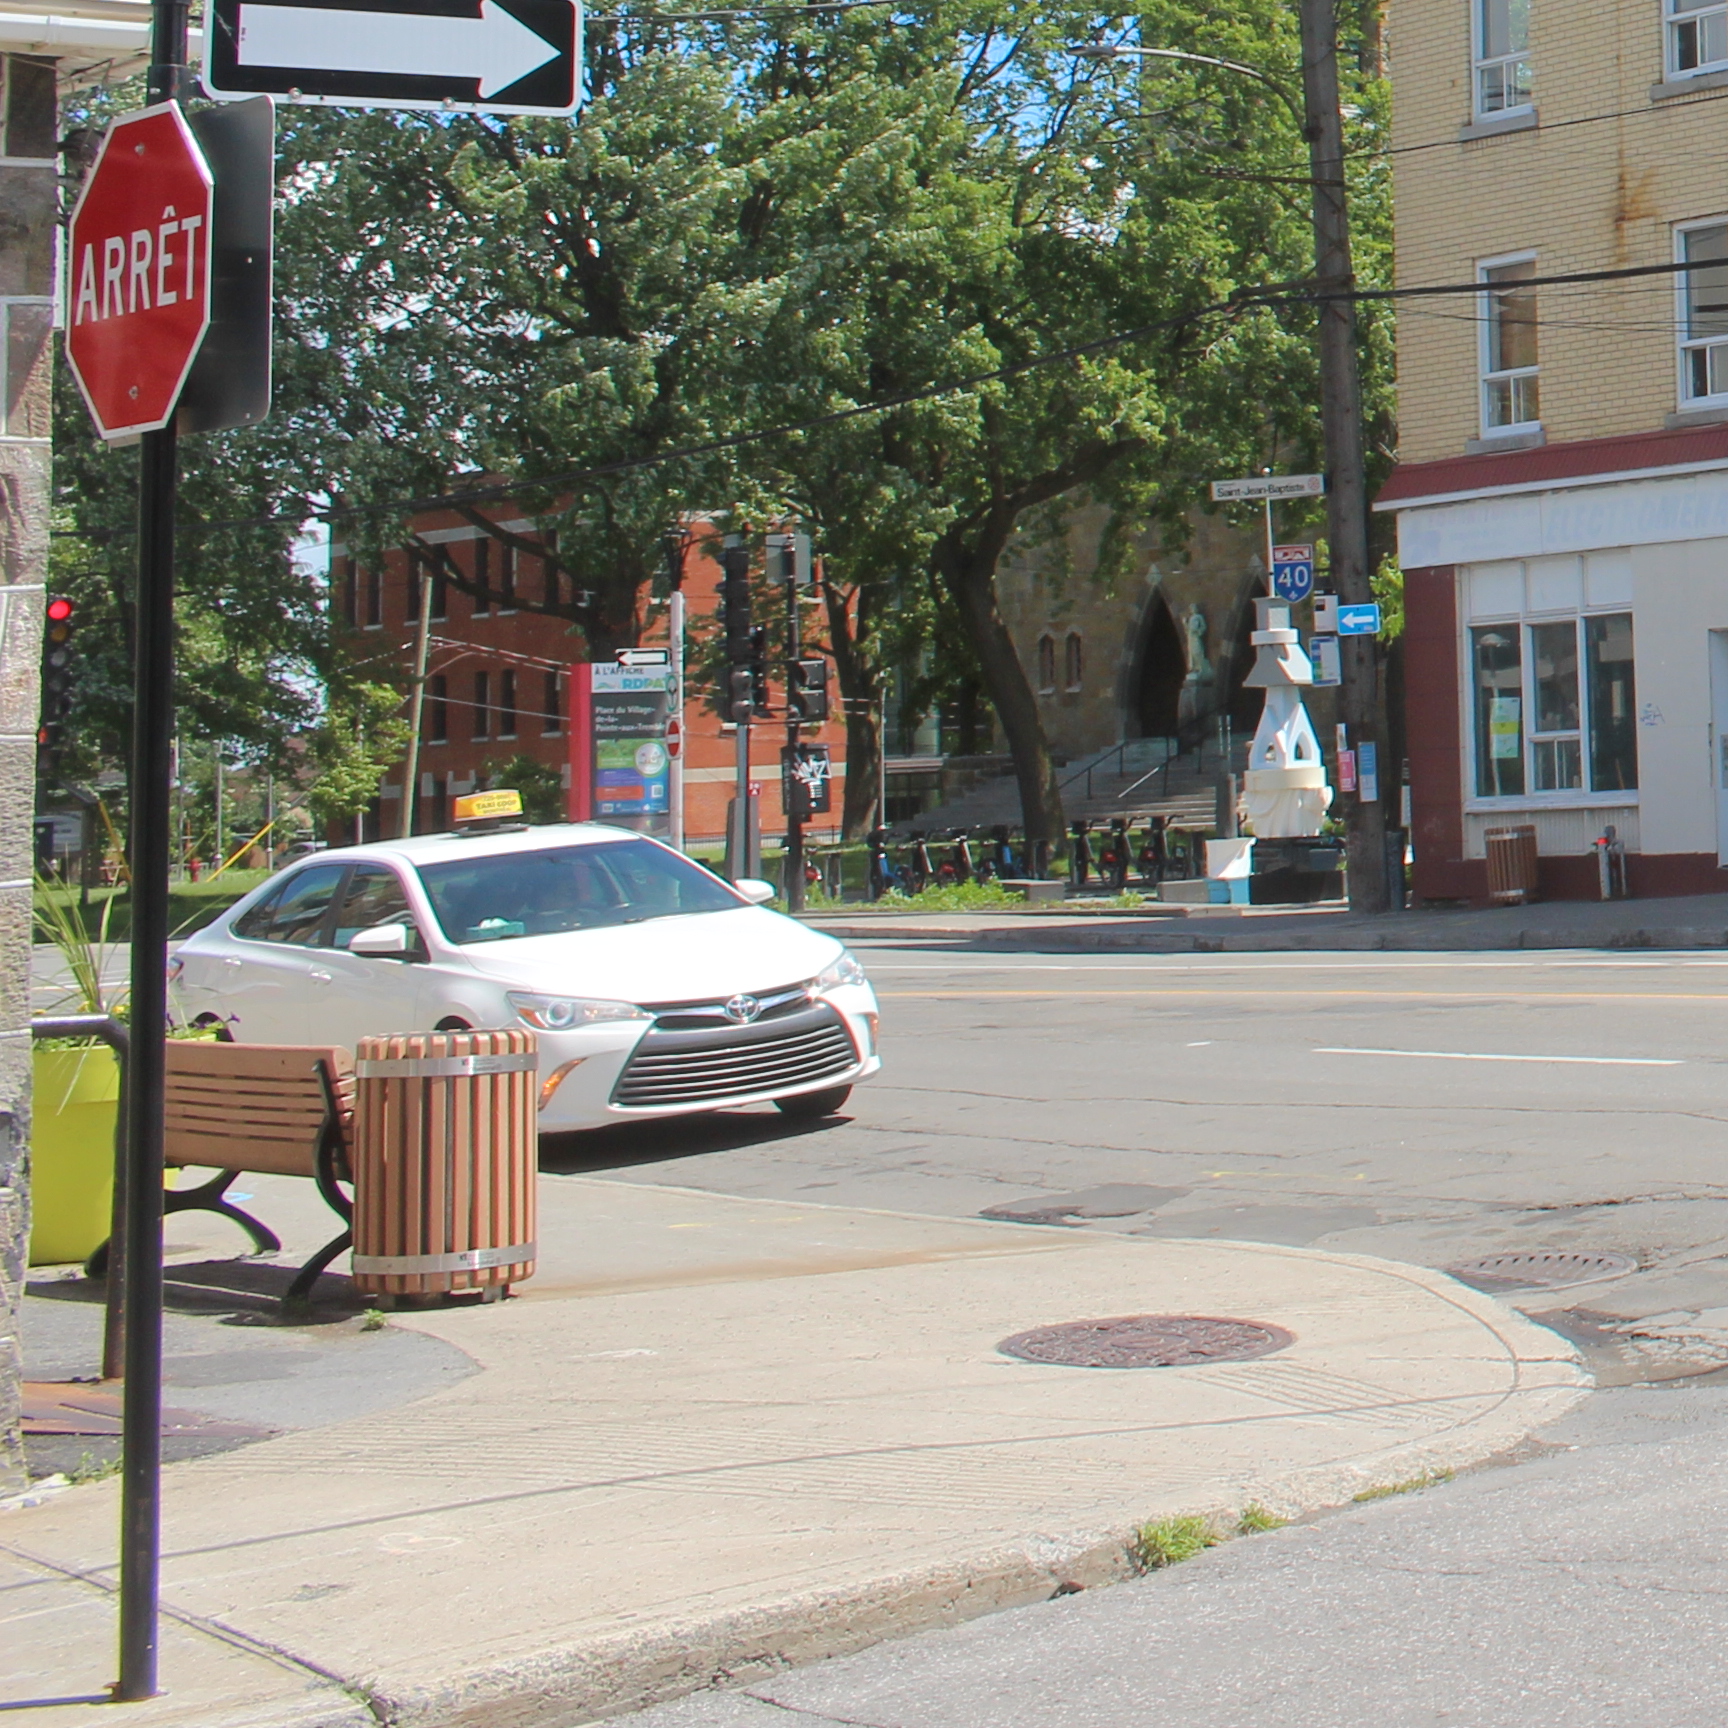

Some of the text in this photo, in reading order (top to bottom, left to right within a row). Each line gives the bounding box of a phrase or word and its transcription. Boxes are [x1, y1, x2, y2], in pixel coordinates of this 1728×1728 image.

[74, 204, 203, 327] ARRÊT
[1217, 483, 1305, 498] Saint-Jean-Baptiste
[1277, 565, 1309, 588] 40
[595, 706, 615, 714] Place
[615, 706, 626, 714] du
[595, 722, 665, 732] Pointe-aux-Tremble
[476, 801, 496, 810] TAXI
